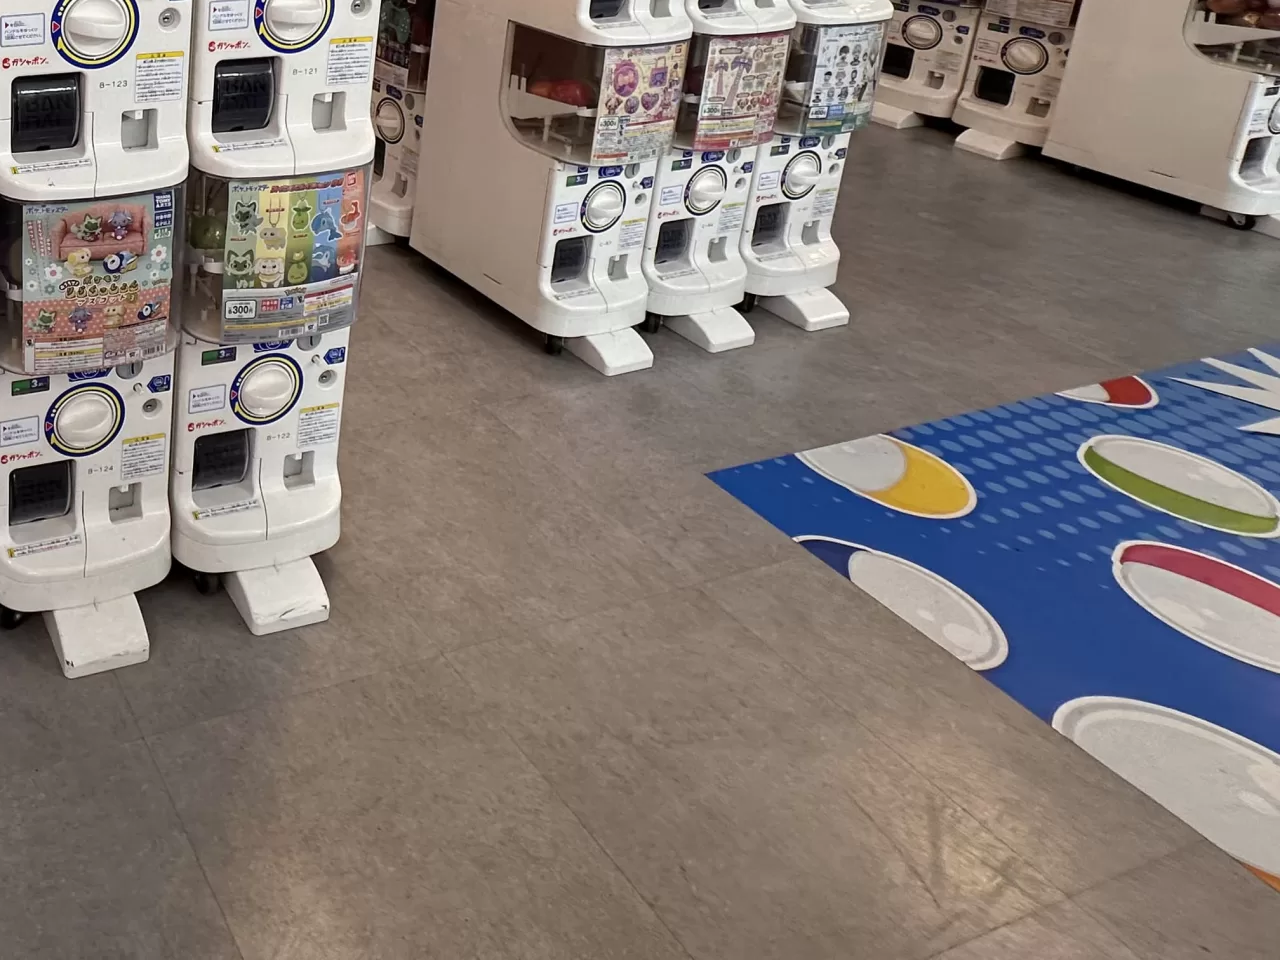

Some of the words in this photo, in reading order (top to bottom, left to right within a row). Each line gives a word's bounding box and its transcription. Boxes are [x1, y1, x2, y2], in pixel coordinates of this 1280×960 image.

[217, 41, 249, 50] ガシャポン
[12, 57, 46, 67] ガシャポン
[99, 80, 127, 89] B-123
[196, 420, 225, 430] ガシャポン
[267, 432, 291, 441] B-122
[9, 452, 41, 462] ガシャポン
[88, 465, 114, 475] B-124
